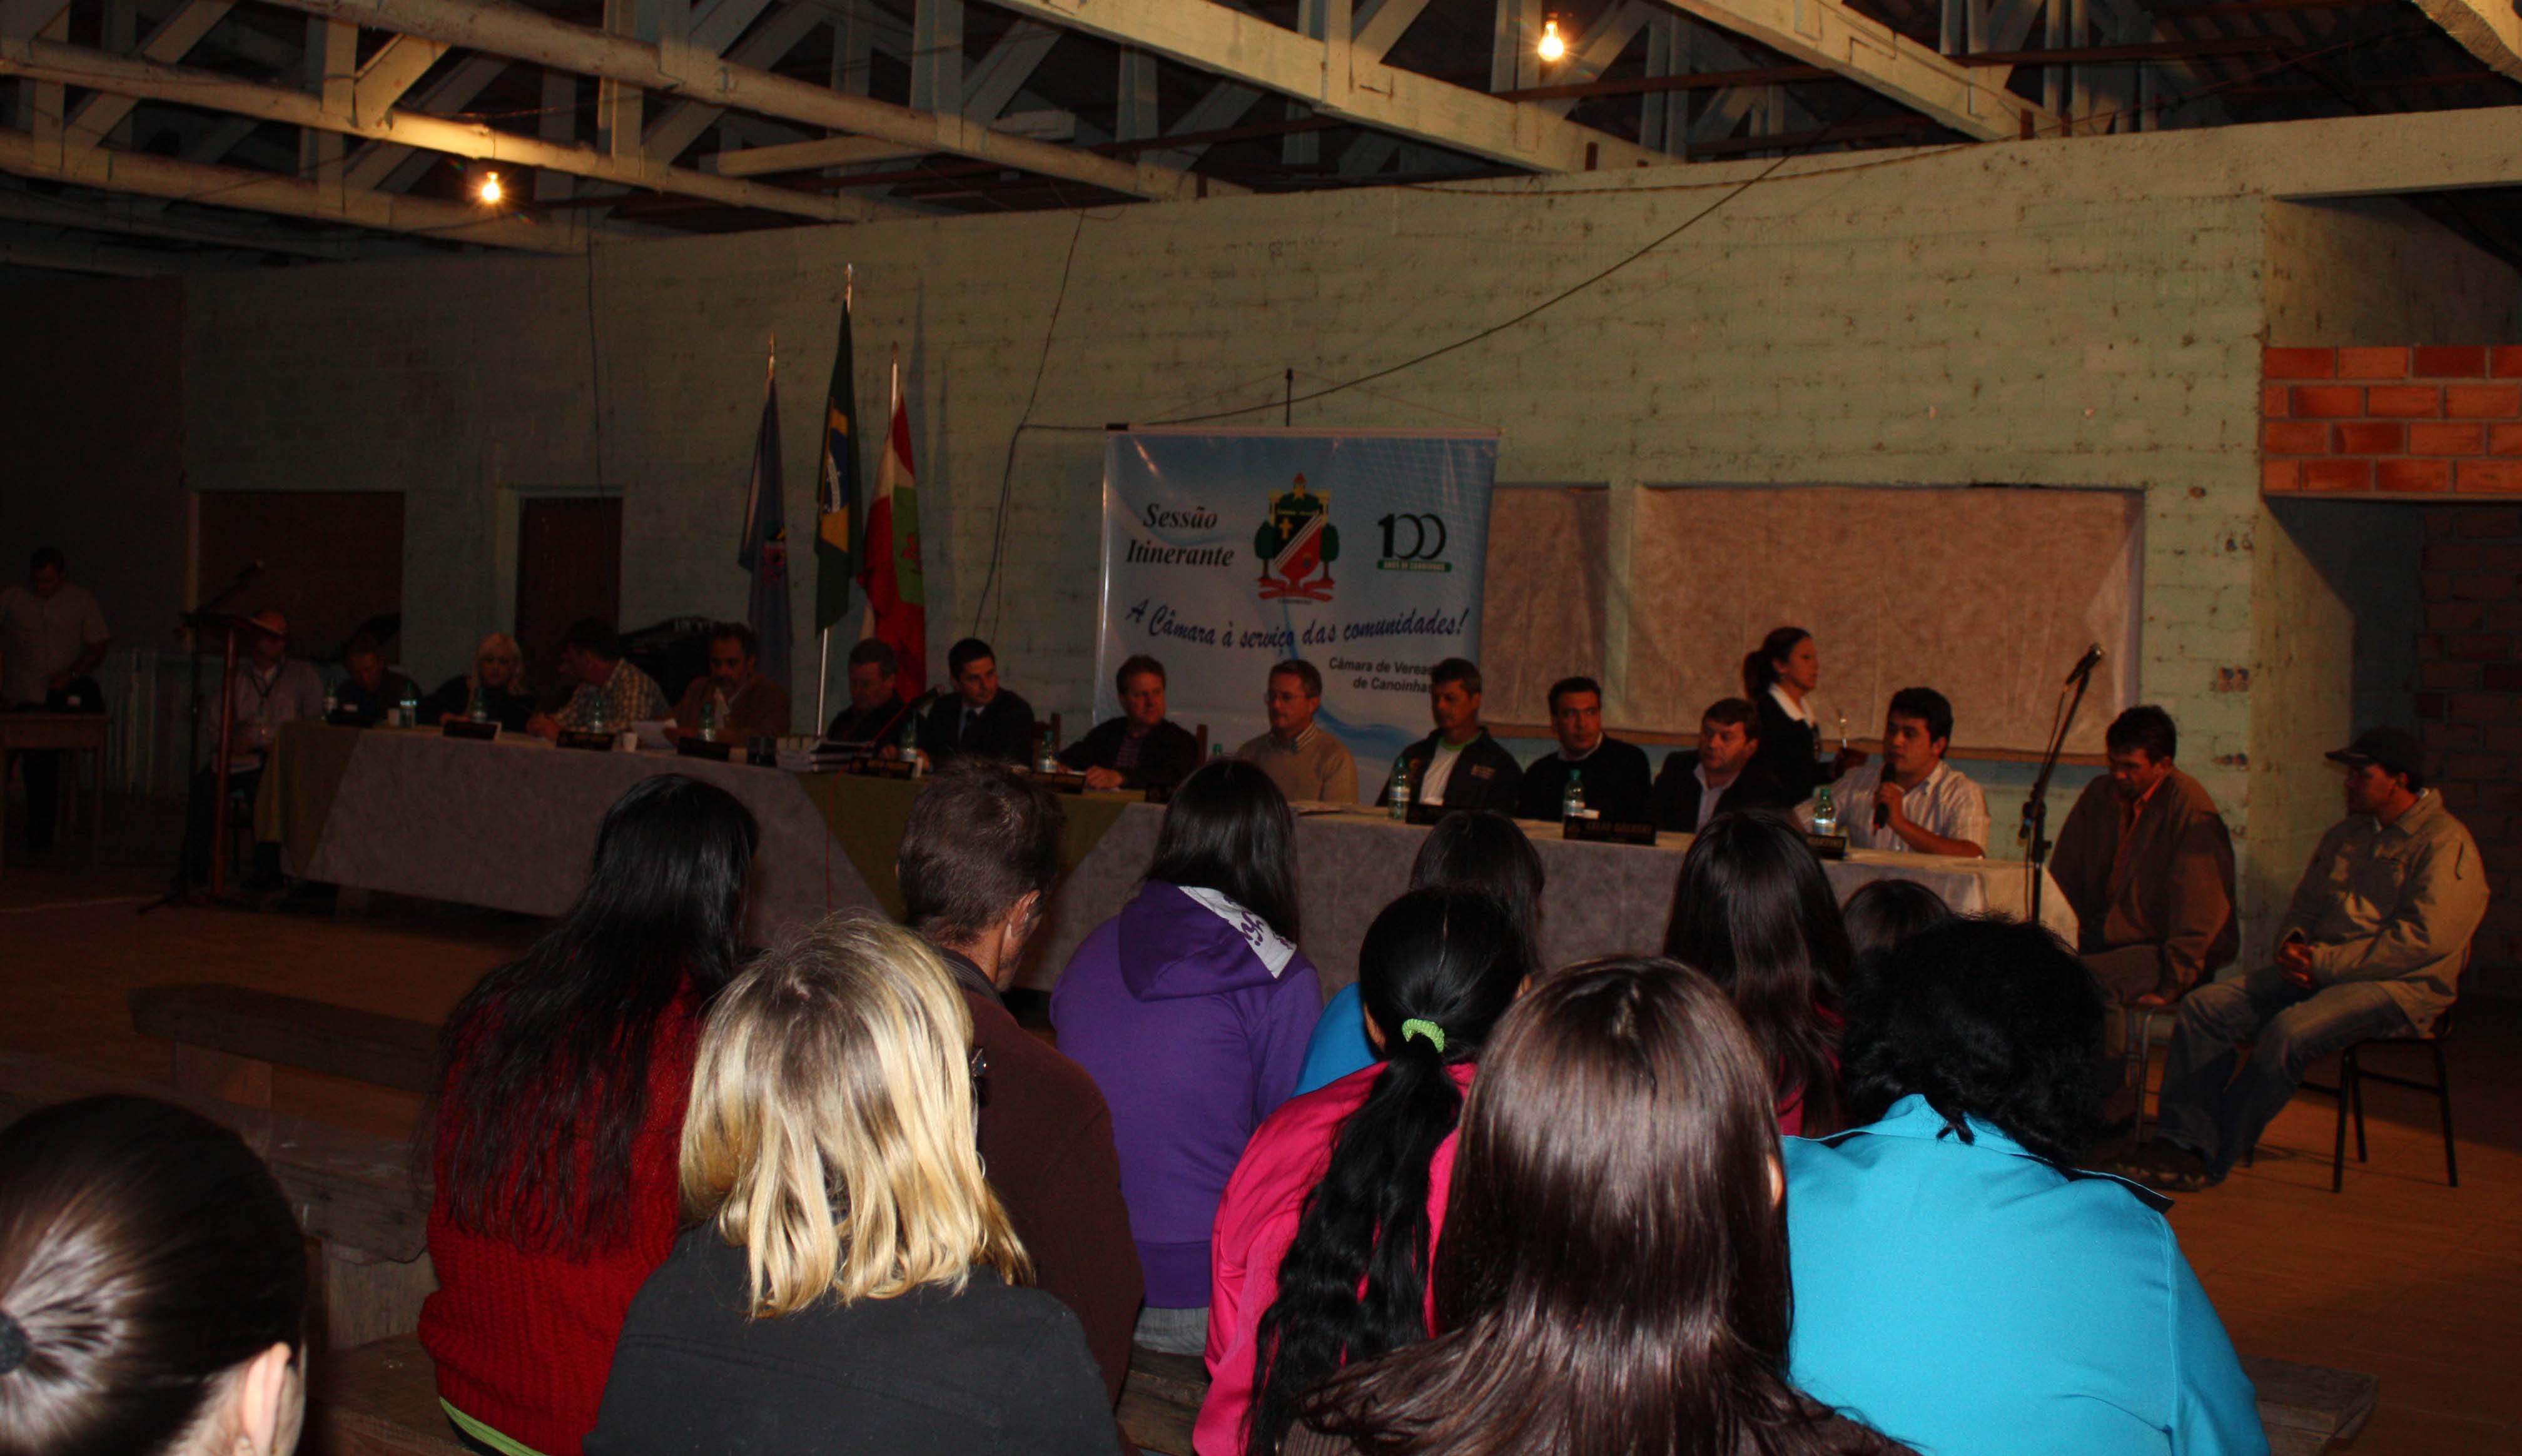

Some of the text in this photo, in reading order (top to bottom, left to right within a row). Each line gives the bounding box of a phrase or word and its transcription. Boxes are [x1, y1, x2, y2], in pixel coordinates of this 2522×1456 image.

[1143, 503, 1218, 528] Sessão
[1127, 539, 1234, 567] Itinerante
[1126, 599, 1469, 656] A Câmara à serviço das comunidades!
[1329, 657, 1433, 675] Câmara de Verea
[1353, 676, 1368, 689] de
